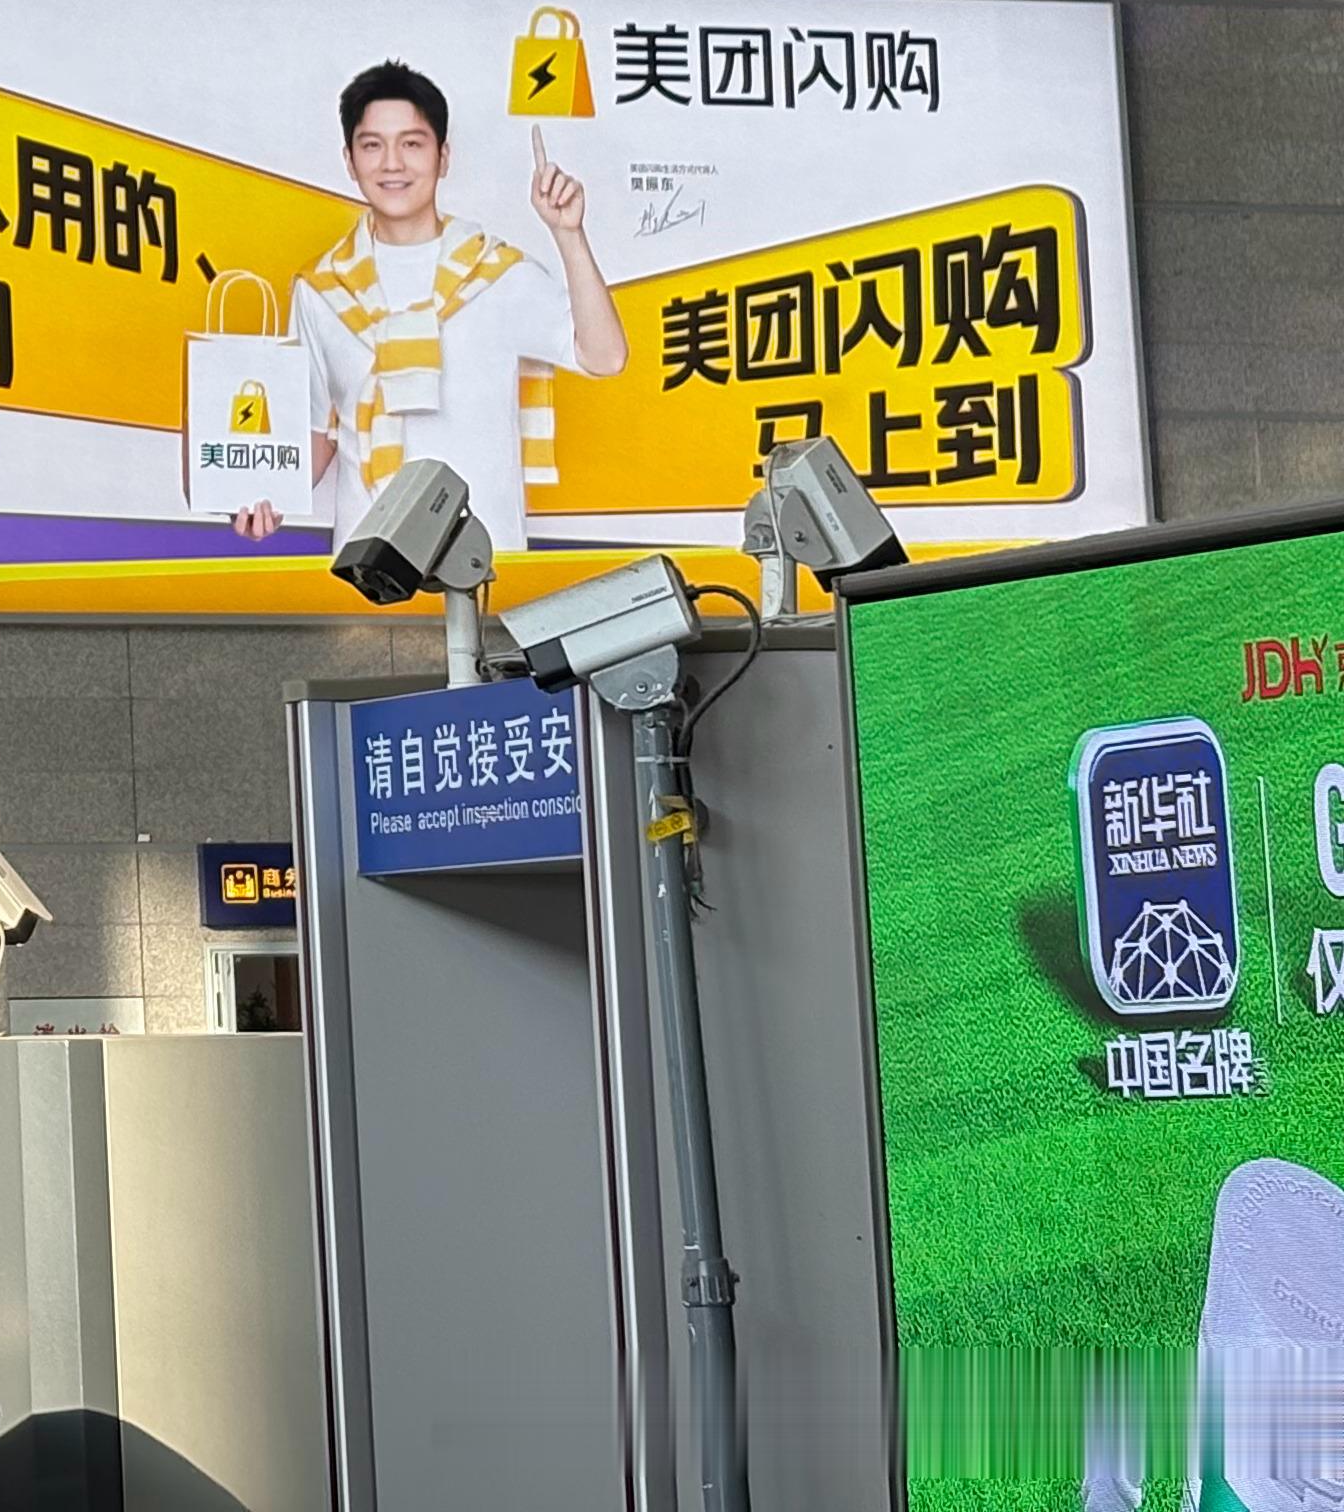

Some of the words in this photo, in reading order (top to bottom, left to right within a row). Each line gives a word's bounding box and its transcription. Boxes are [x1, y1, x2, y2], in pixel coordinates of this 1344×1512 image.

[613, 23, 939, 113] 美团闪购
[661, 223, 1059, 393] 美团闪购
[199, 442, 300, 471] 美团闪购
[365, 707, 574, 801] 请自觉接受安
[370, 810, 412, 836] Please
[418, 804, 461, 833] accept
[461, 796, 530, 829] inspection
[1103, 770, 1217, 848] 新华社
[1108, 848, 1170, 877] XINHUA
[1171, 843, 1218, 871] NEWS
[1105, 1028, 1253, 1100] 中国名牌
